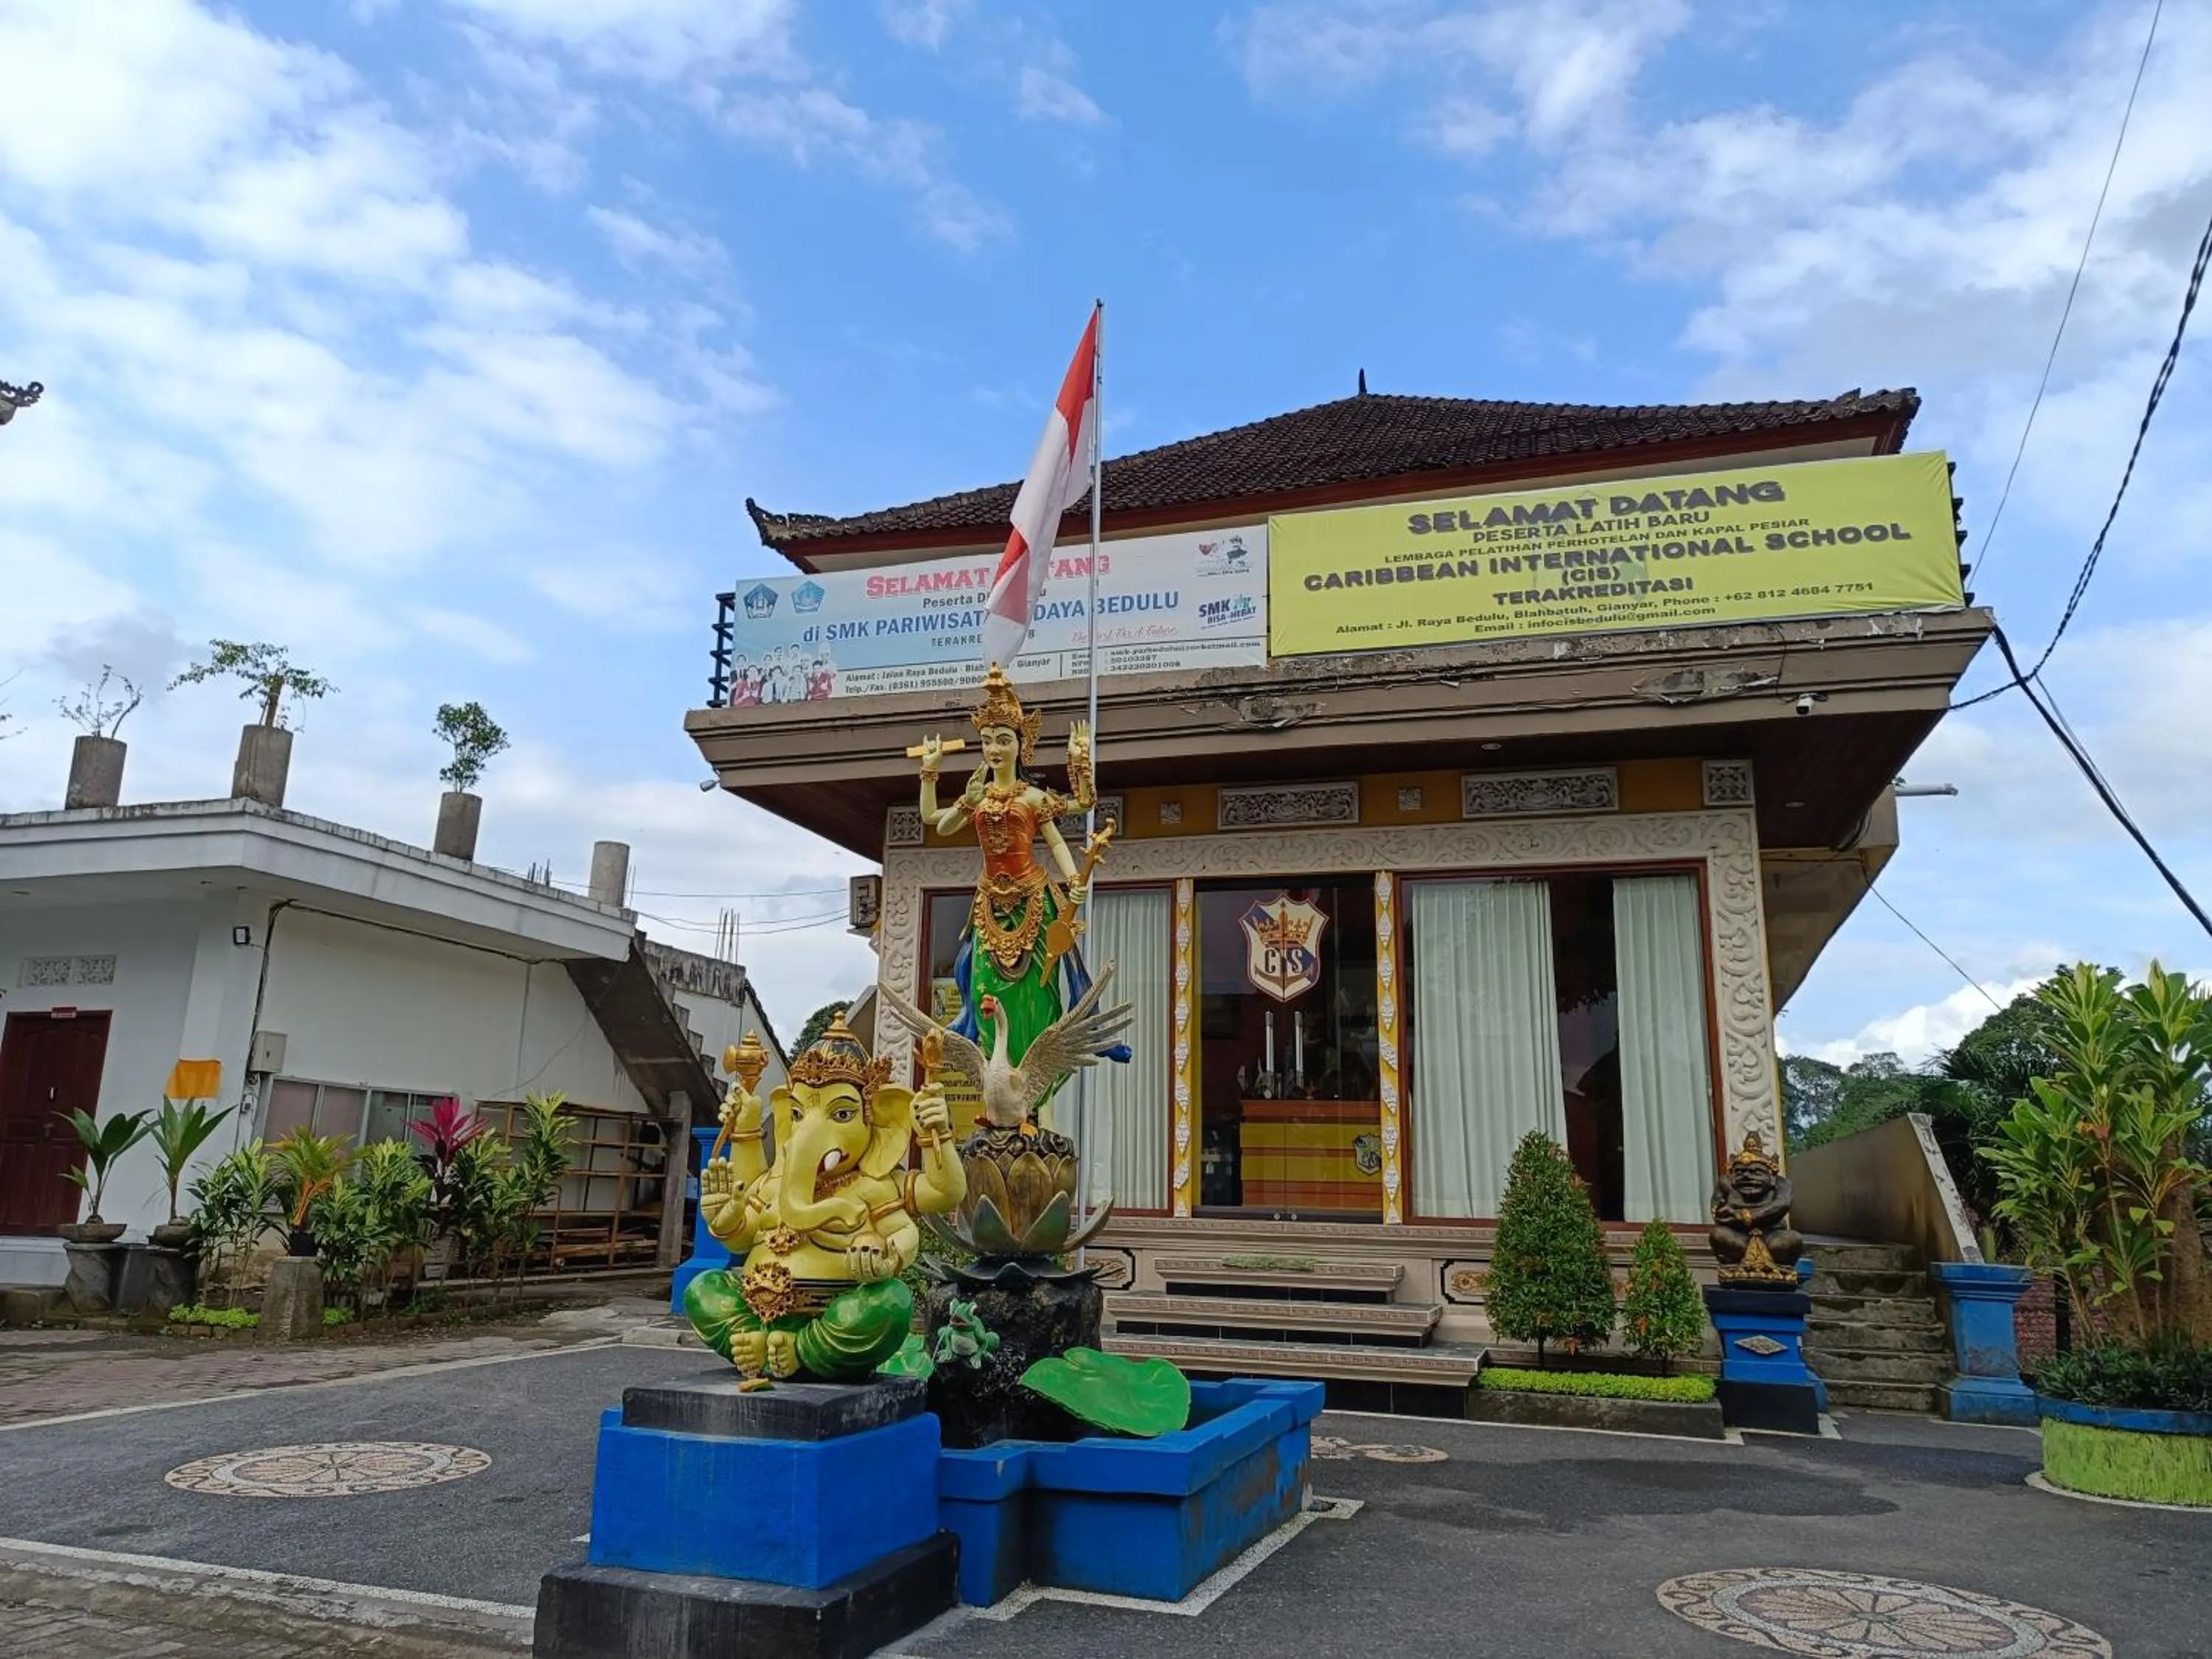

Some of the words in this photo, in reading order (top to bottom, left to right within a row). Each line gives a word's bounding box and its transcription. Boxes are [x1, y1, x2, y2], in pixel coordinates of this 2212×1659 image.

[1408, 498, 1599, 535] SELAMAT
[1610, 481, 1785, 516] DATANG
[1385, 551, 1454, 563] LEMBAGA
[1459, 542, 1542, 556] PELATIHAN
[1548, 533, 1649, 549] PERHOTELAN
[1655, 529, 1687, 539] DAN
[1693, 524, 1745, 535] KAPAL
[1750, 518, 1809, 531] PESIAR
[1473, 524, 1568, 543] PESERTA
[1576, 517, 1640, 535] LATIH
[1648, 511, 1709, 528] BARU
[1304, 560, 1478, 591] CARIBBEAN
[1489, 537, 1756, 574] INTERNATIONAL
[1765, 523, 1912, 550] SCHOOL
[866, 568, 990, 598] SELAMAT
[1562, 566, 1620, 585] (CIS)
[923, 594, 973, 608] Peserta
[1492, 577, 1694, 605] TERAKREDITASI
[804, 626, 819, 642] di
[826, 621, 869, 640] SMK
[876, 611, 986, 636] PARIWISAT
[1094, 591, 1178, 614] BEDULU
[1198, 598, 1231, 617] SMK
[1335, 622, 1383, 633] Alamat
[1417, 618, 1451, 627] Raya
[1456, 613, 1509, 623] Bedulu,
[1514, 605, 1592, 619] Blahbatuh,
[1597, 600, 1658, 611] Gianyar,
[1663, 596, 1709, 606] Phone
[1724, 592, 1752, 602] +62
[1758, 589, 1786, 599] 812
[1834, 582, 1873, 592] 7751
[1475, 624, 1514, 633] Email
[1528, 607, 1716, 627] infocisbedulu@gmail.com
[846, 672, 875, 681] Alamat
[906, 669, 926, 677] Raya
[928, 666, 958, 675] Bedulu
[1017, 658, 1051, 668] Gianyar
